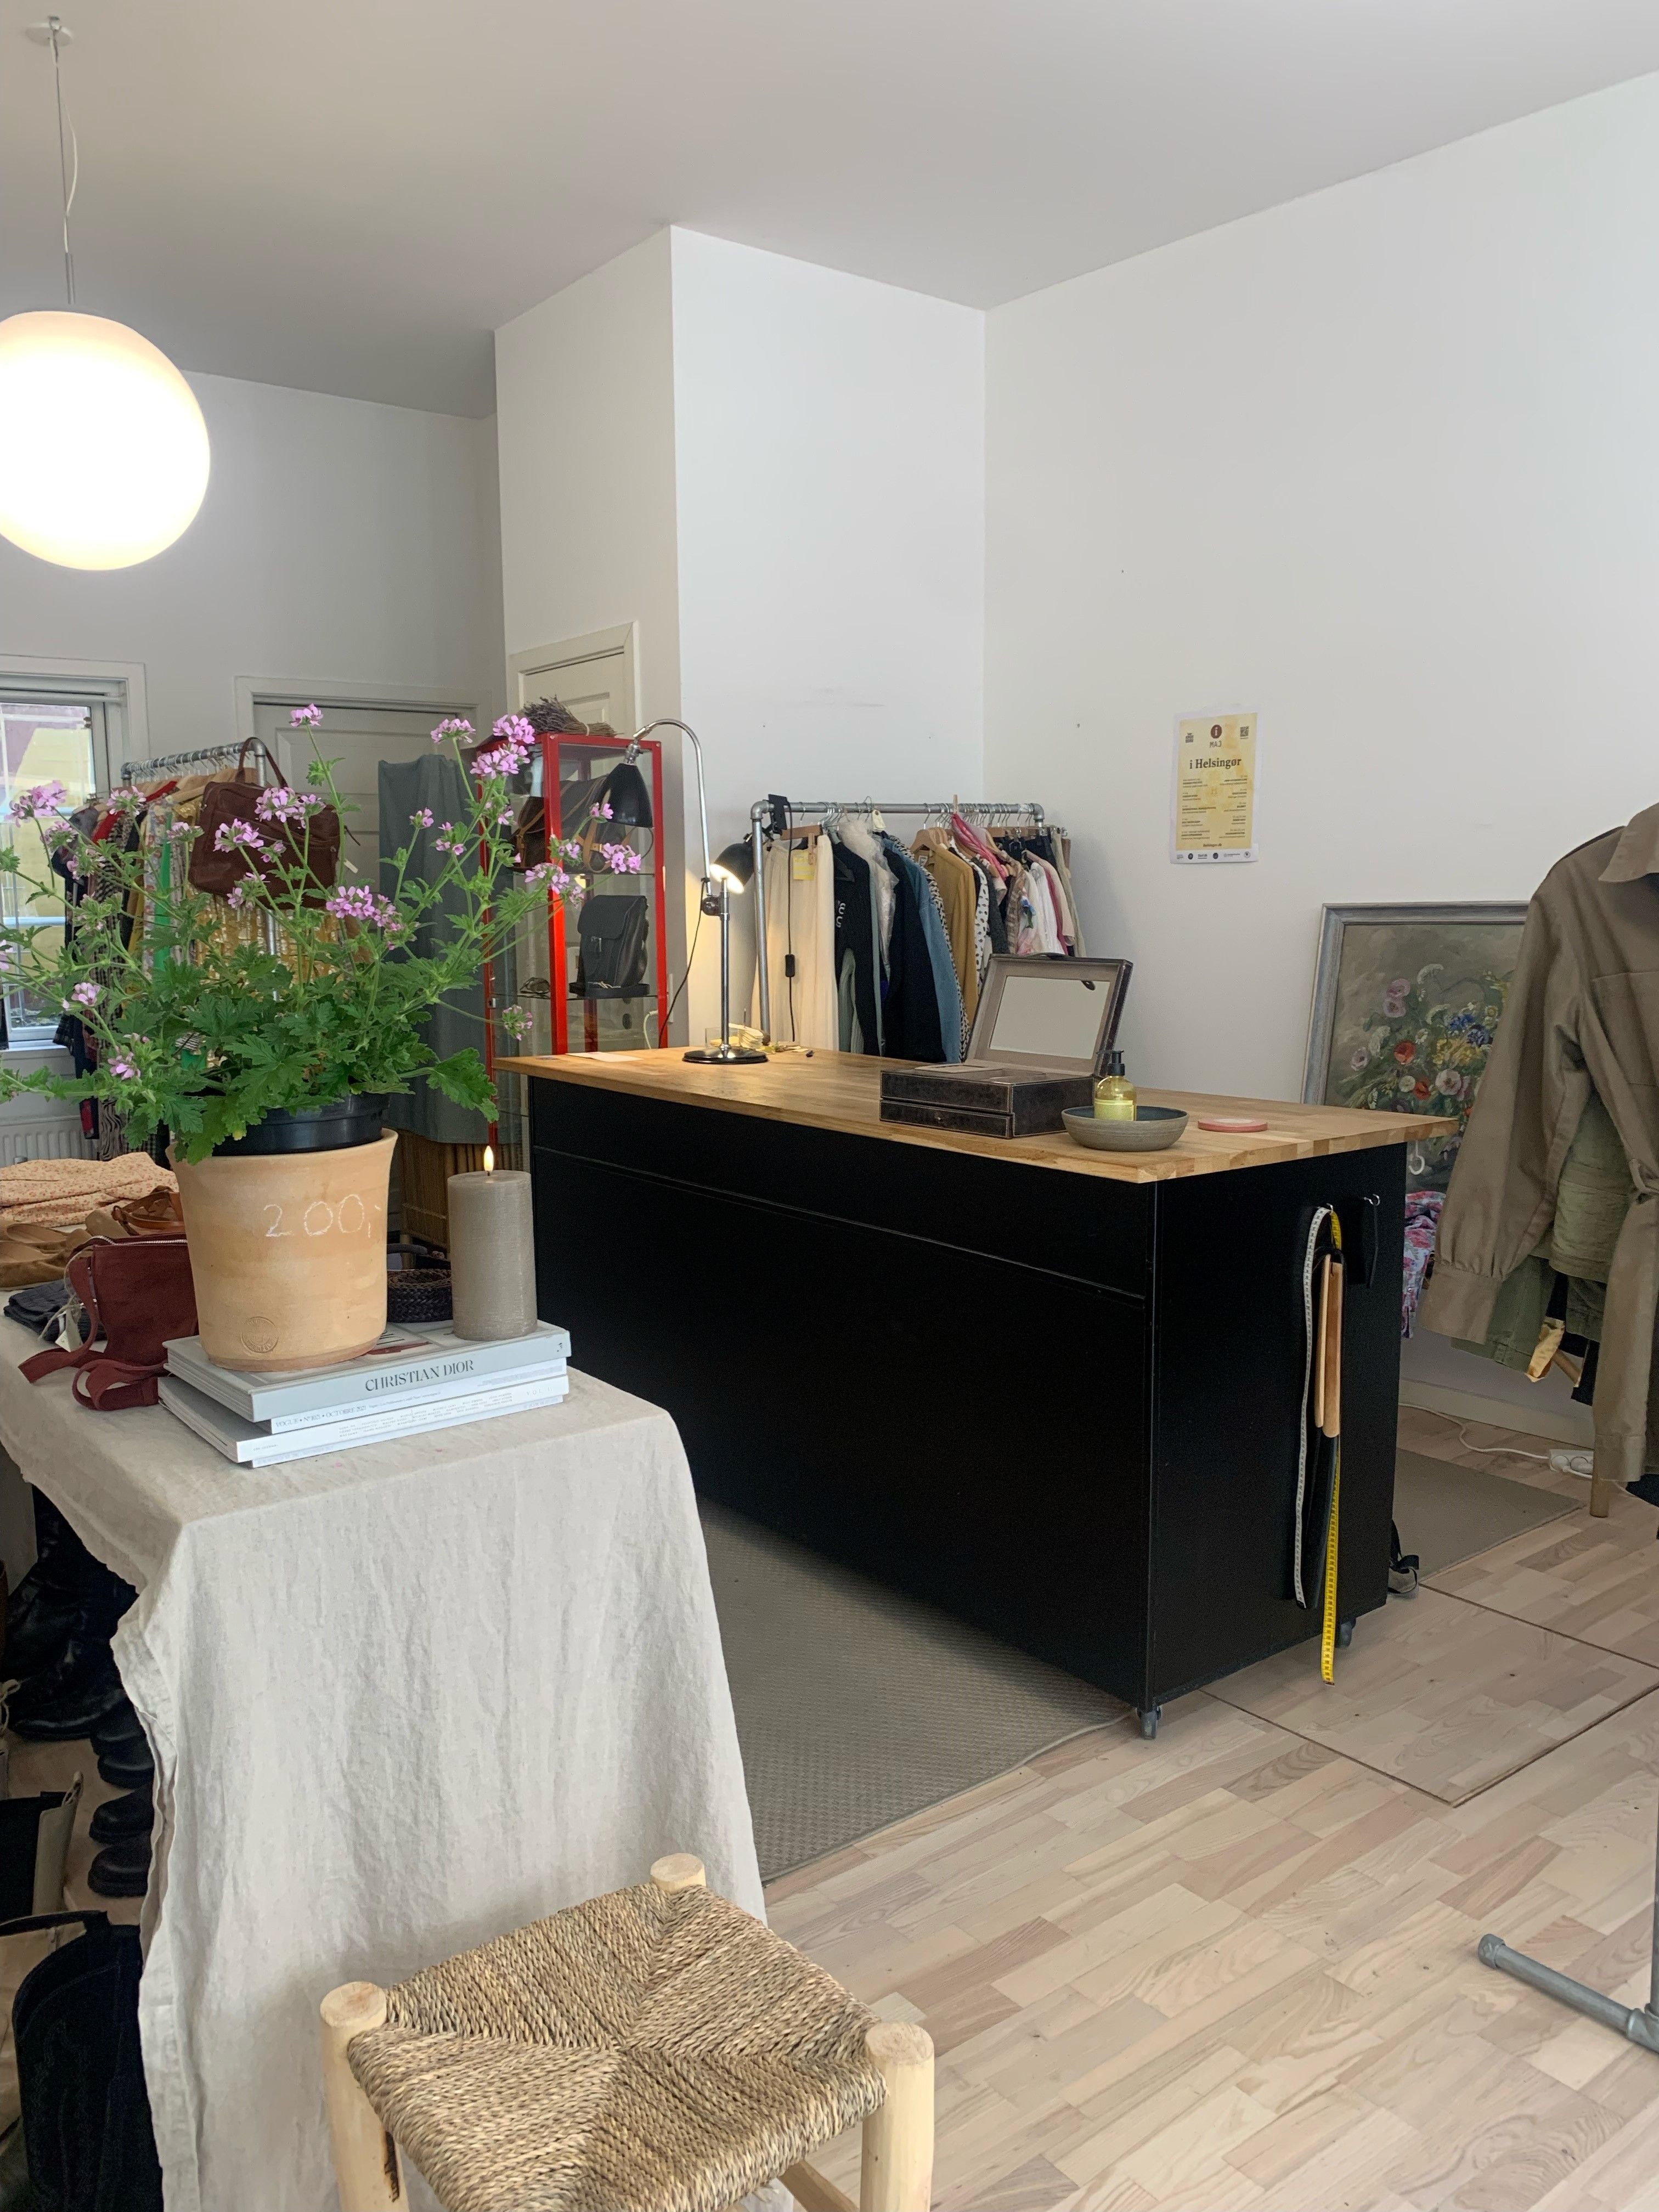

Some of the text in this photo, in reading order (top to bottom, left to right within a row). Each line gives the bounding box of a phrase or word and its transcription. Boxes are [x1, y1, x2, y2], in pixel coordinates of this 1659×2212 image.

[1189, 758, 1242, 770] i Helsingør
[365, 1365, 439, 1392] CHRISTIAN
[444, 1359, 474, 1376] DIOR
[275, 1419, 298, 1427] VOGUE
[325, 1407, 354, 1418] OCTOBRE
